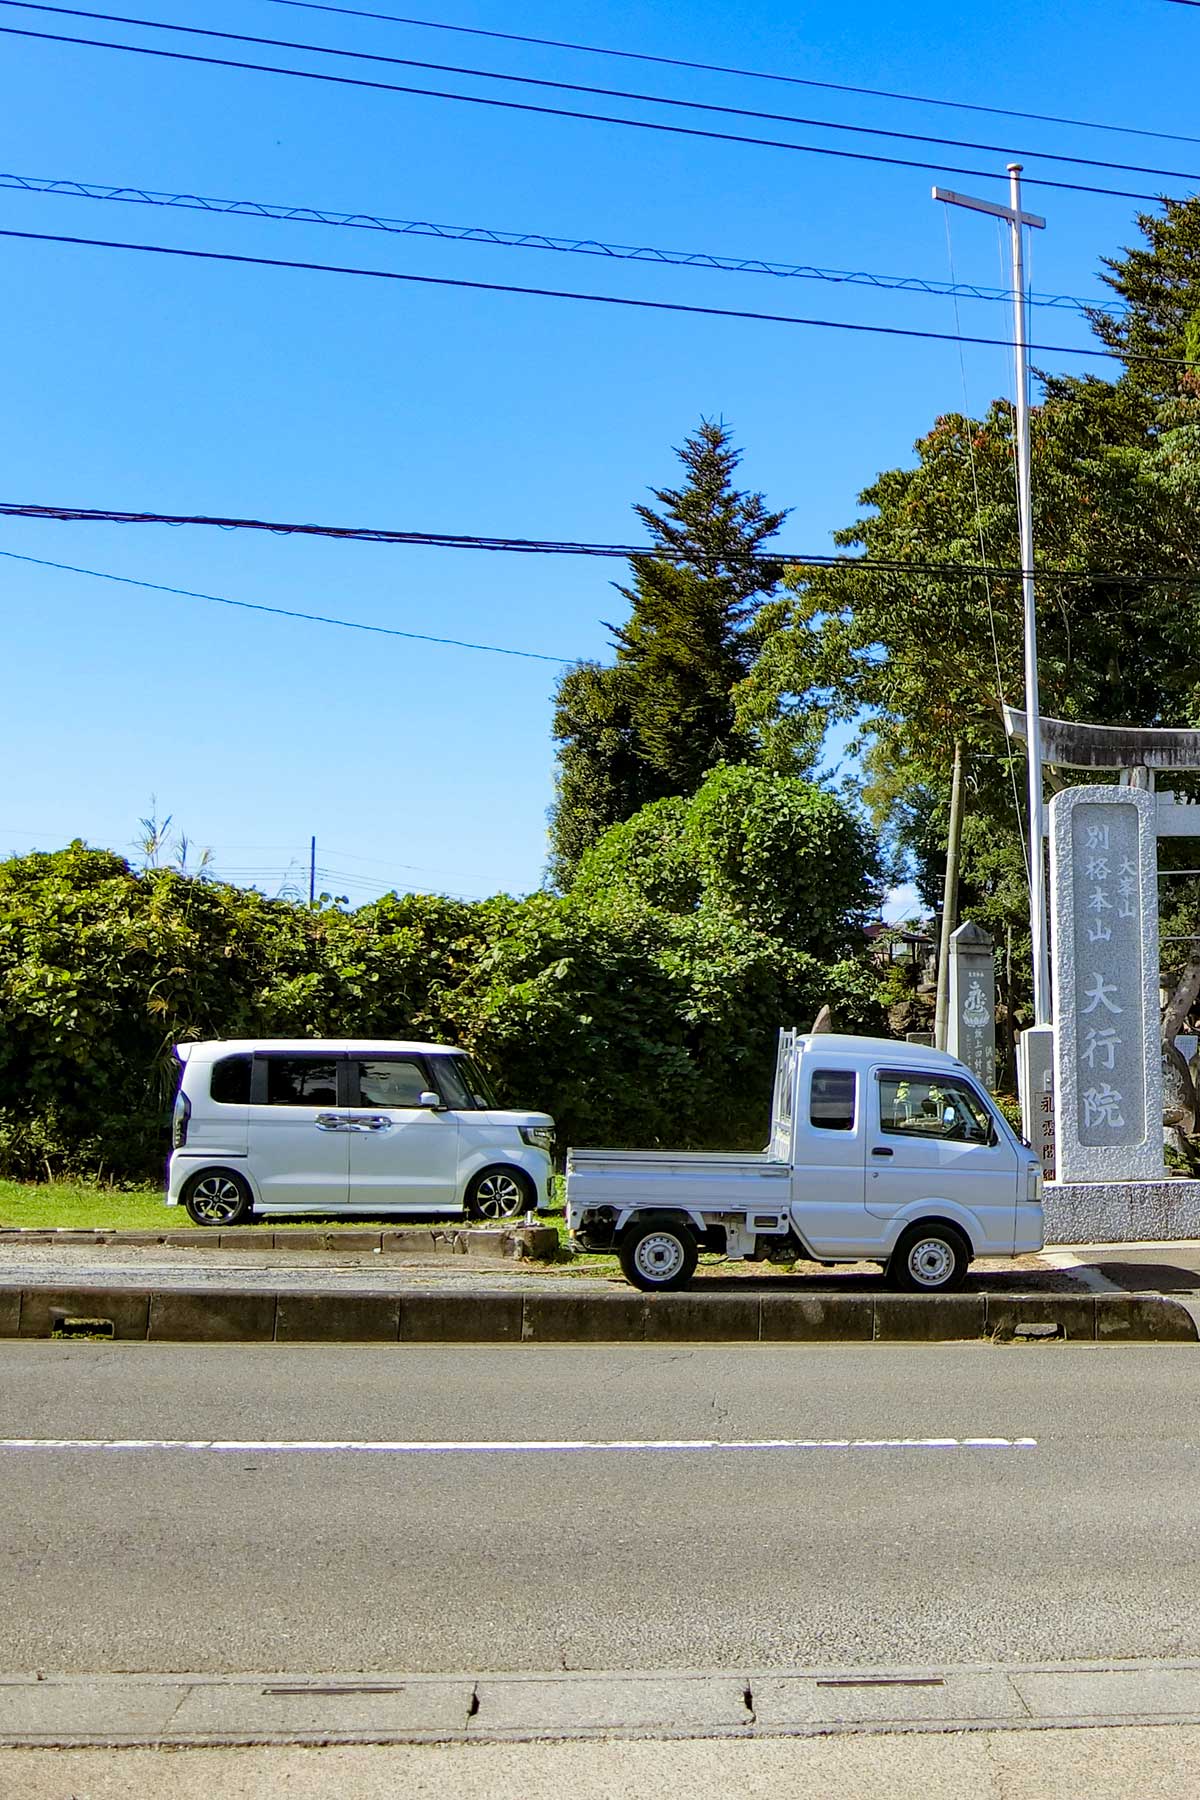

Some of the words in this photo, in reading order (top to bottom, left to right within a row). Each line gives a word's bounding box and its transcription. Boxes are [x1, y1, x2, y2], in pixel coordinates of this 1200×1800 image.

[1084, 823, 1113, 942] 別格本山
[1117, 855, 1137, 919] 大峯山
[1080, 971, 1125, 1128] 大行院
